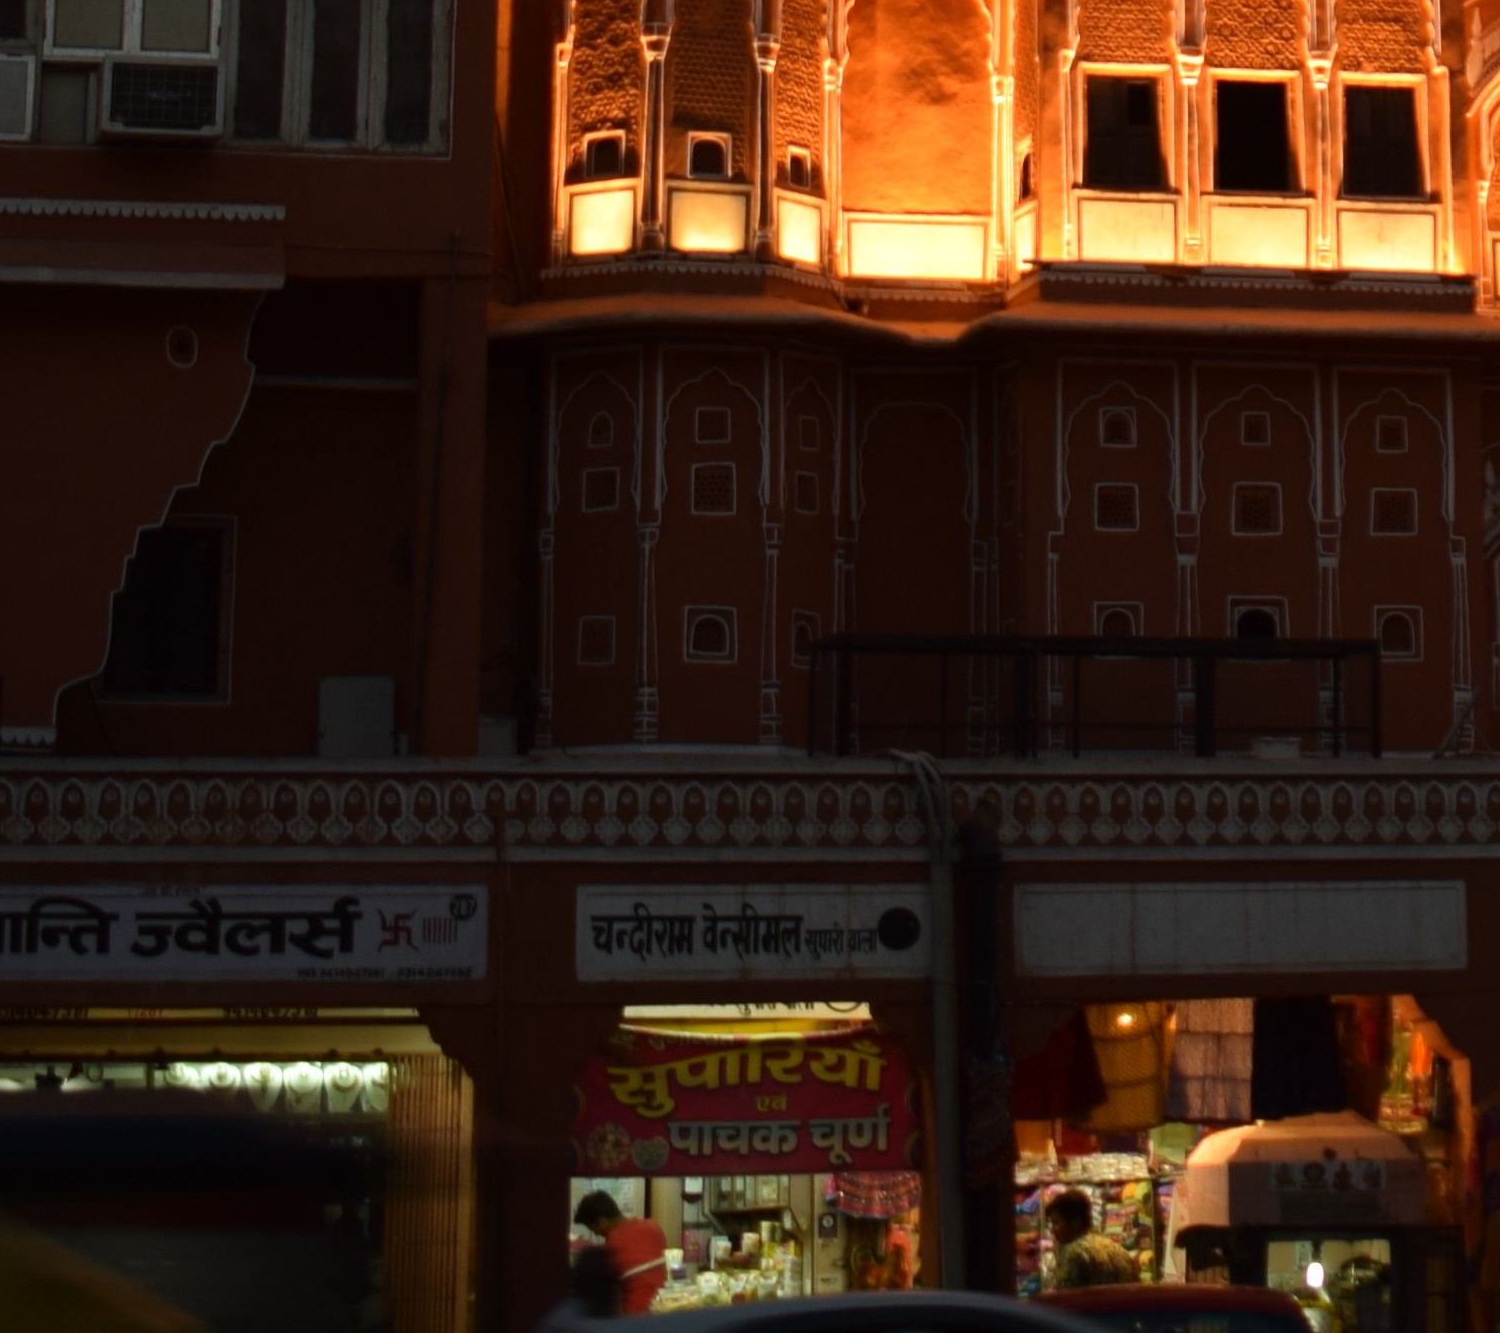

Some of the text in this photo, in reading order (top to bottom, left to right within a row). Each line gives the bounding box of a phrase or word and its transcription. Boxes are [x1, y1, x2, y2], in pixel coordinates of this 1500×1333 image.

[130, 896, 362, 960] ज्वैलर्स
[590, 902, 697, 962] चन्दीराम
[607, 1040, 889, 1118] सुपारियाँ
[756, 1094, 788, 1113] एवं
[668, 1103, 892, 1165] पाचक चूर्ण
